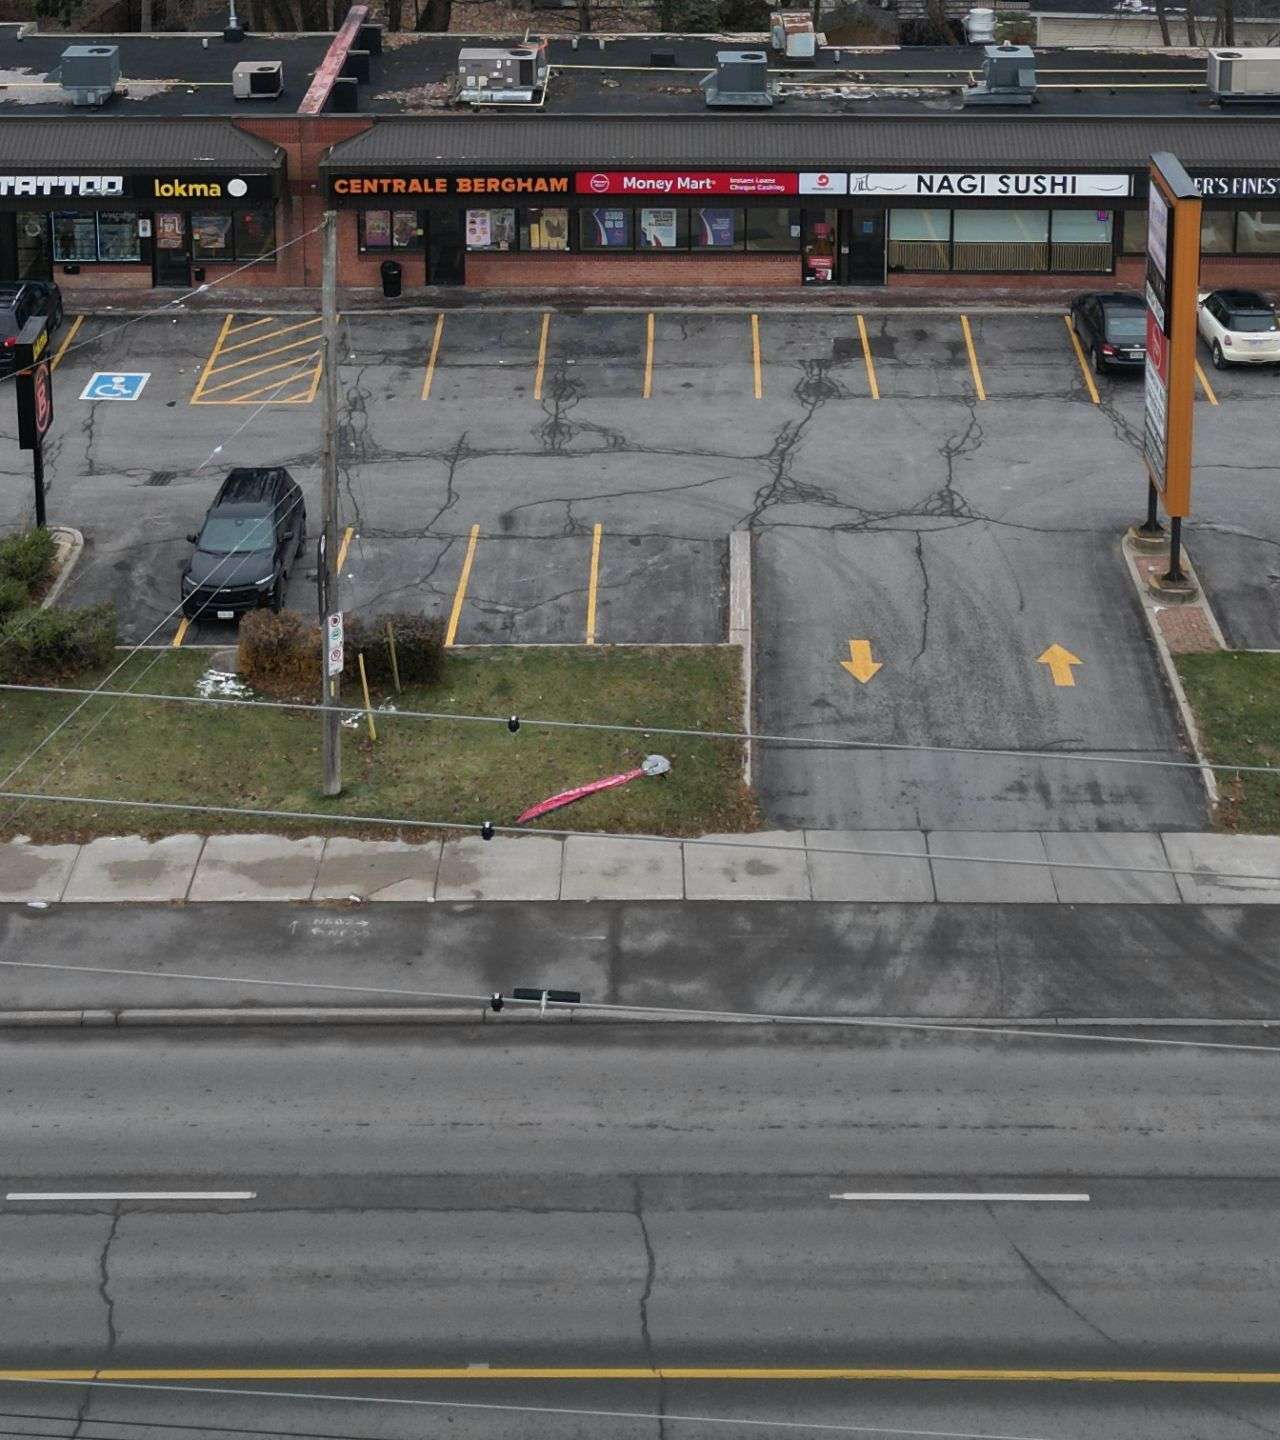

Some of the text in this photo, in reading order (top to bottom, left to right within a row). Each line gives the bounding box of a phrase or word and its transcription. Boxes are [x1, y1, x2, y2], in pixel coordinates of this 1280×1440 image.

[154, 178, 222, 197] lokma
[334, 177, 569, 194] CENTRALE BERGHAM
[623, 177, 672, 192] Money
[677, 177, 713, 190] Mart
[916, 174, 1077, 194] NAGI SUSHI
